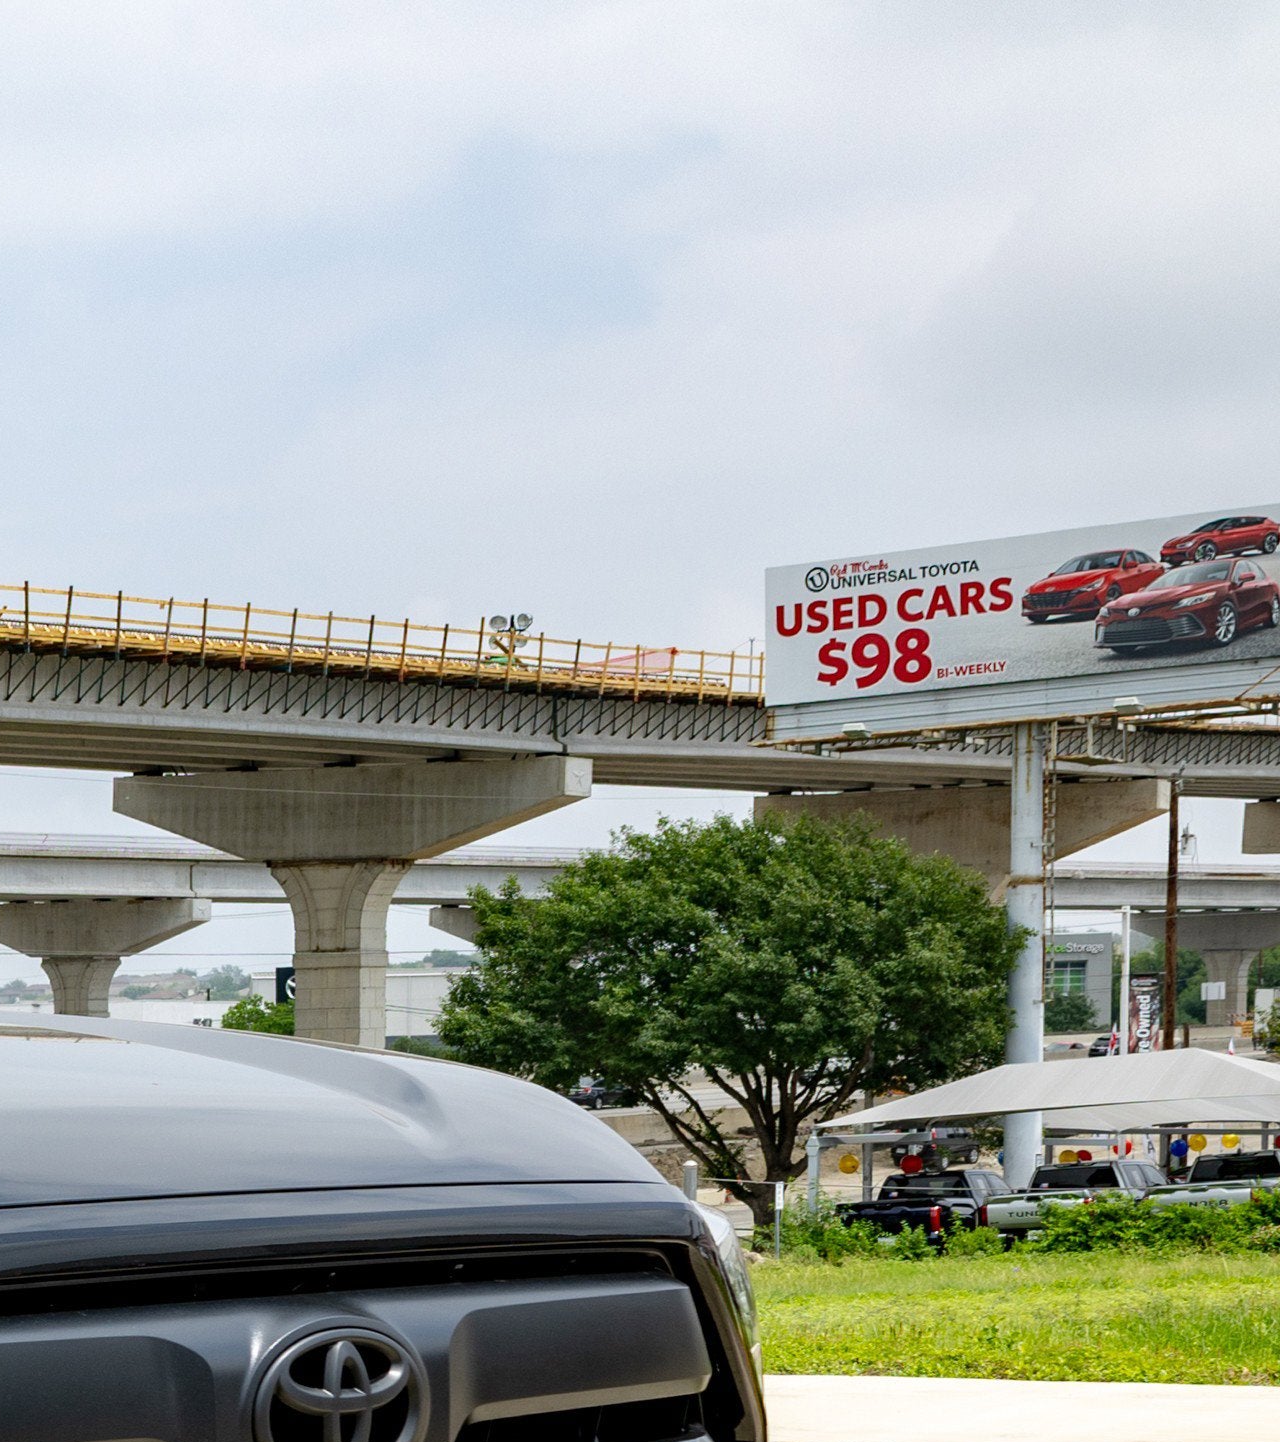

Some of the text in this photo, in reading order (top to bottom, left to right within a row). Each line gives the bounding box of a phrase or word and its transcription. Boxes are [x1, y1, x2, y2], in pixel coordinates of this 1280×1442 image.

[831, 560, 980, 590] UNIVERSAL TOYOTA
[776, 576, 1014, 637] USED CARS
[817, 628, 1007, 689] $98 BI-WEEKLY
[1136, 994, 1151, 1038] Owned
